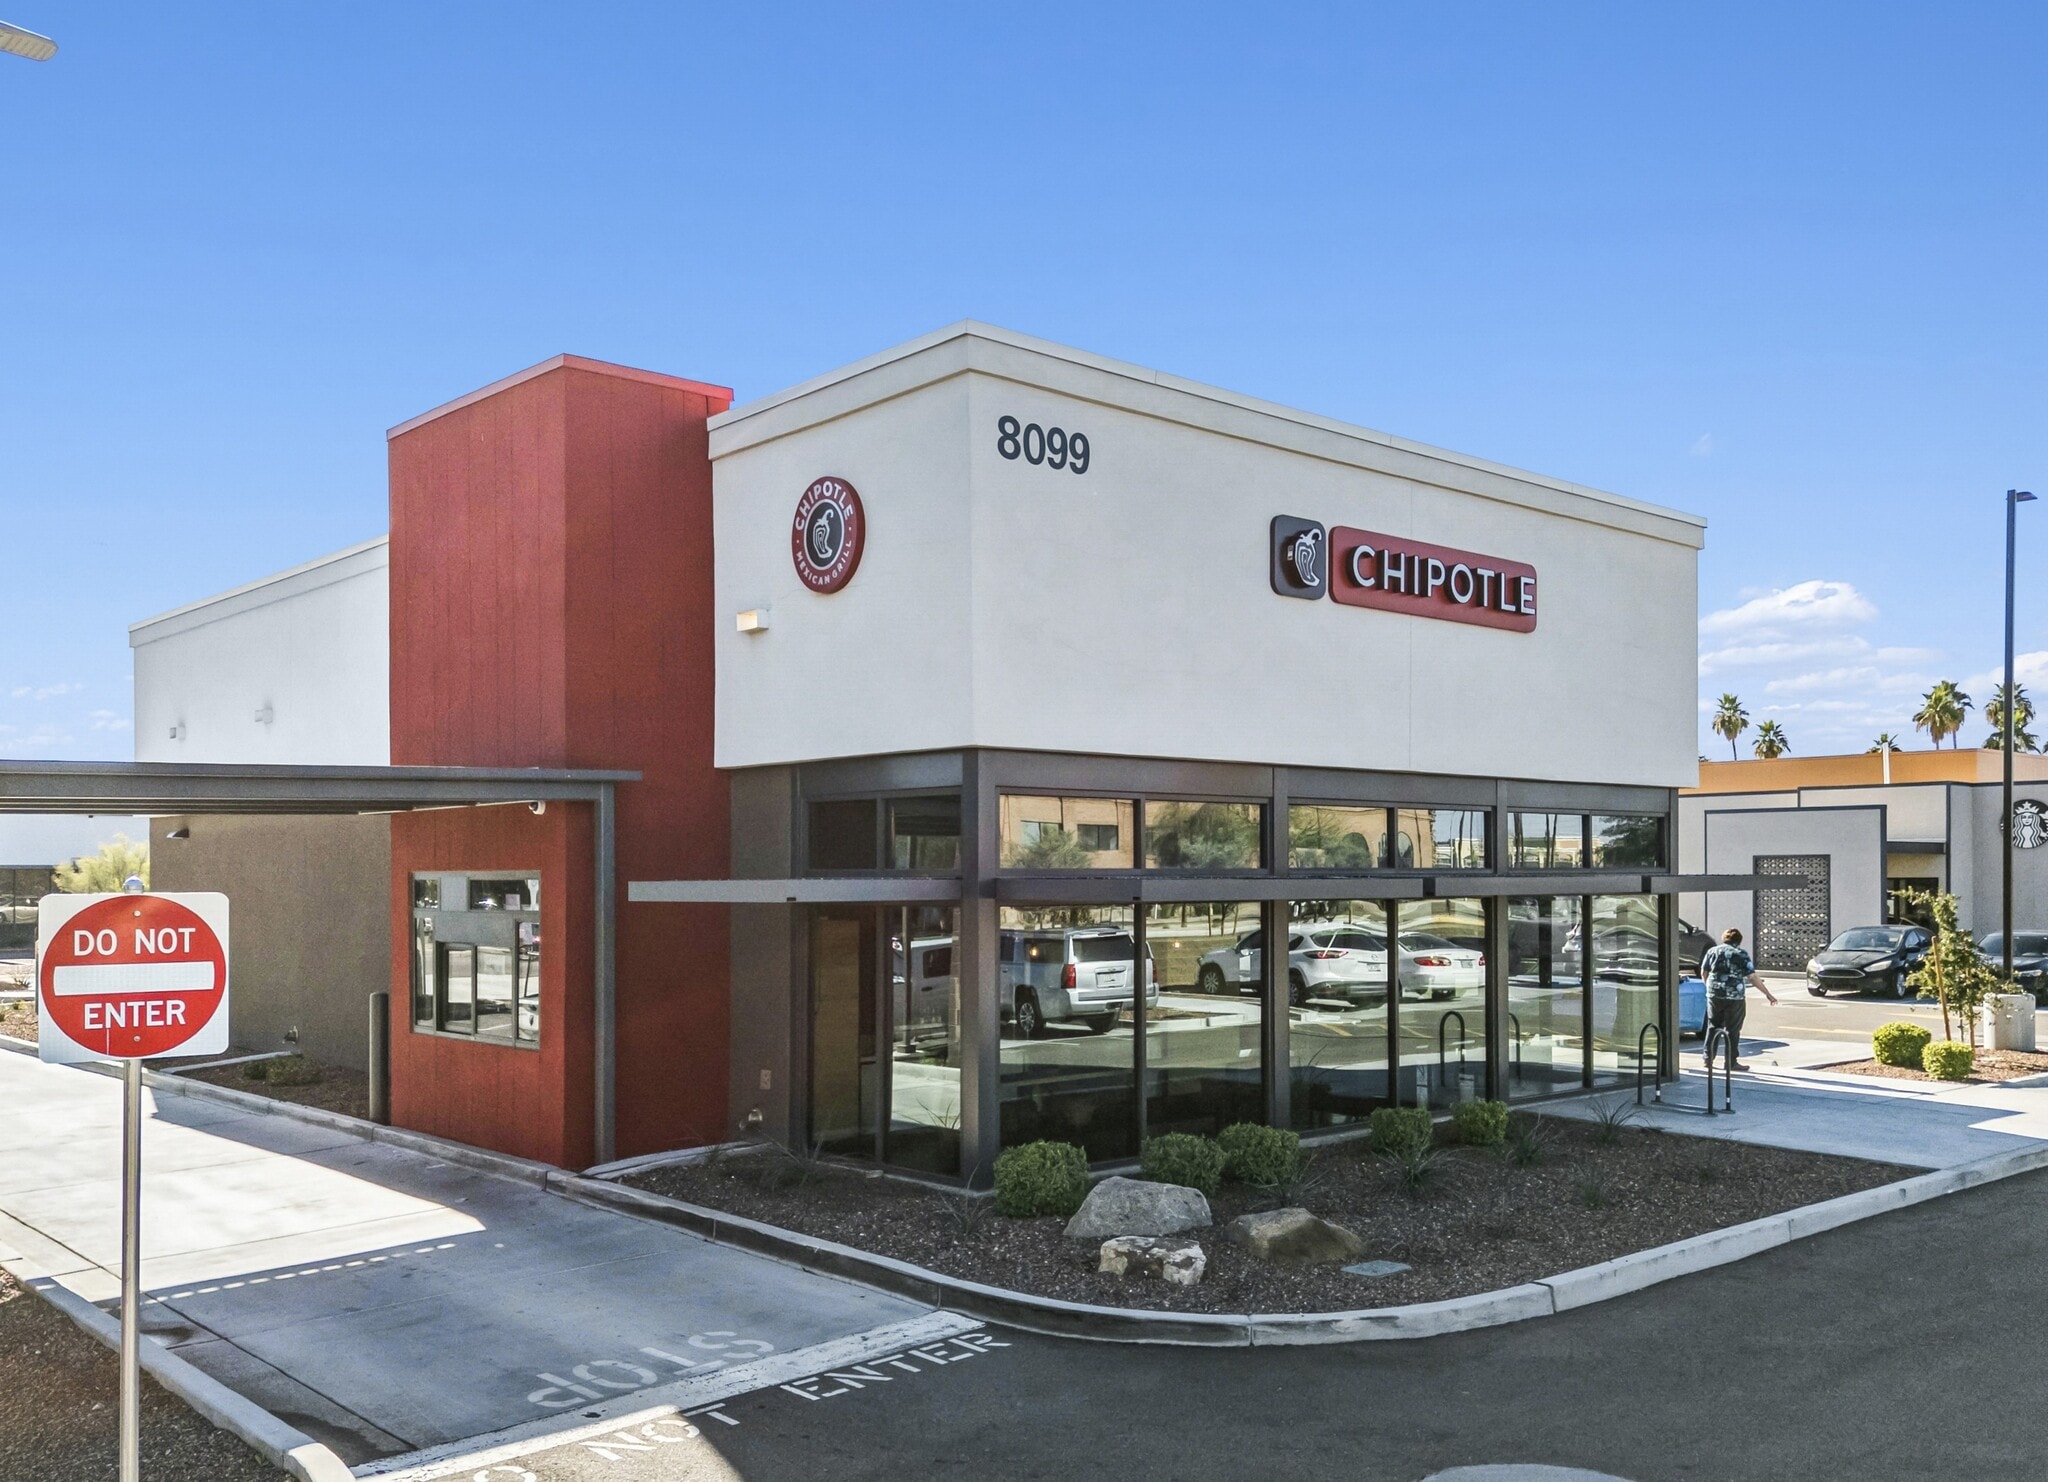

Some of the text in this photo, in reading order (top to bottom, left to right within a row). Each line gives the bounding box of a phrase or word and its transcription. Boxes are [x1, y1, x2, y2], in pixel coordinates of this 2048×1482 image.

[997, 415, 1090, 475] 8099
[795, 481, 853, 530] CHIPOTLE
[796, 540, 851, 585] MEXICAN GRILL
[1352, 544, 1536, 614] CHIPOTLE
[73, 927, 196, 956] DO NOT
[84, 999, 186, 1030] ENTER
[527, 1331, 774, 1407] STOP
[579, 1402, 740, 1461] NOT
[780, 1333, 1012, 1401] ENTER
